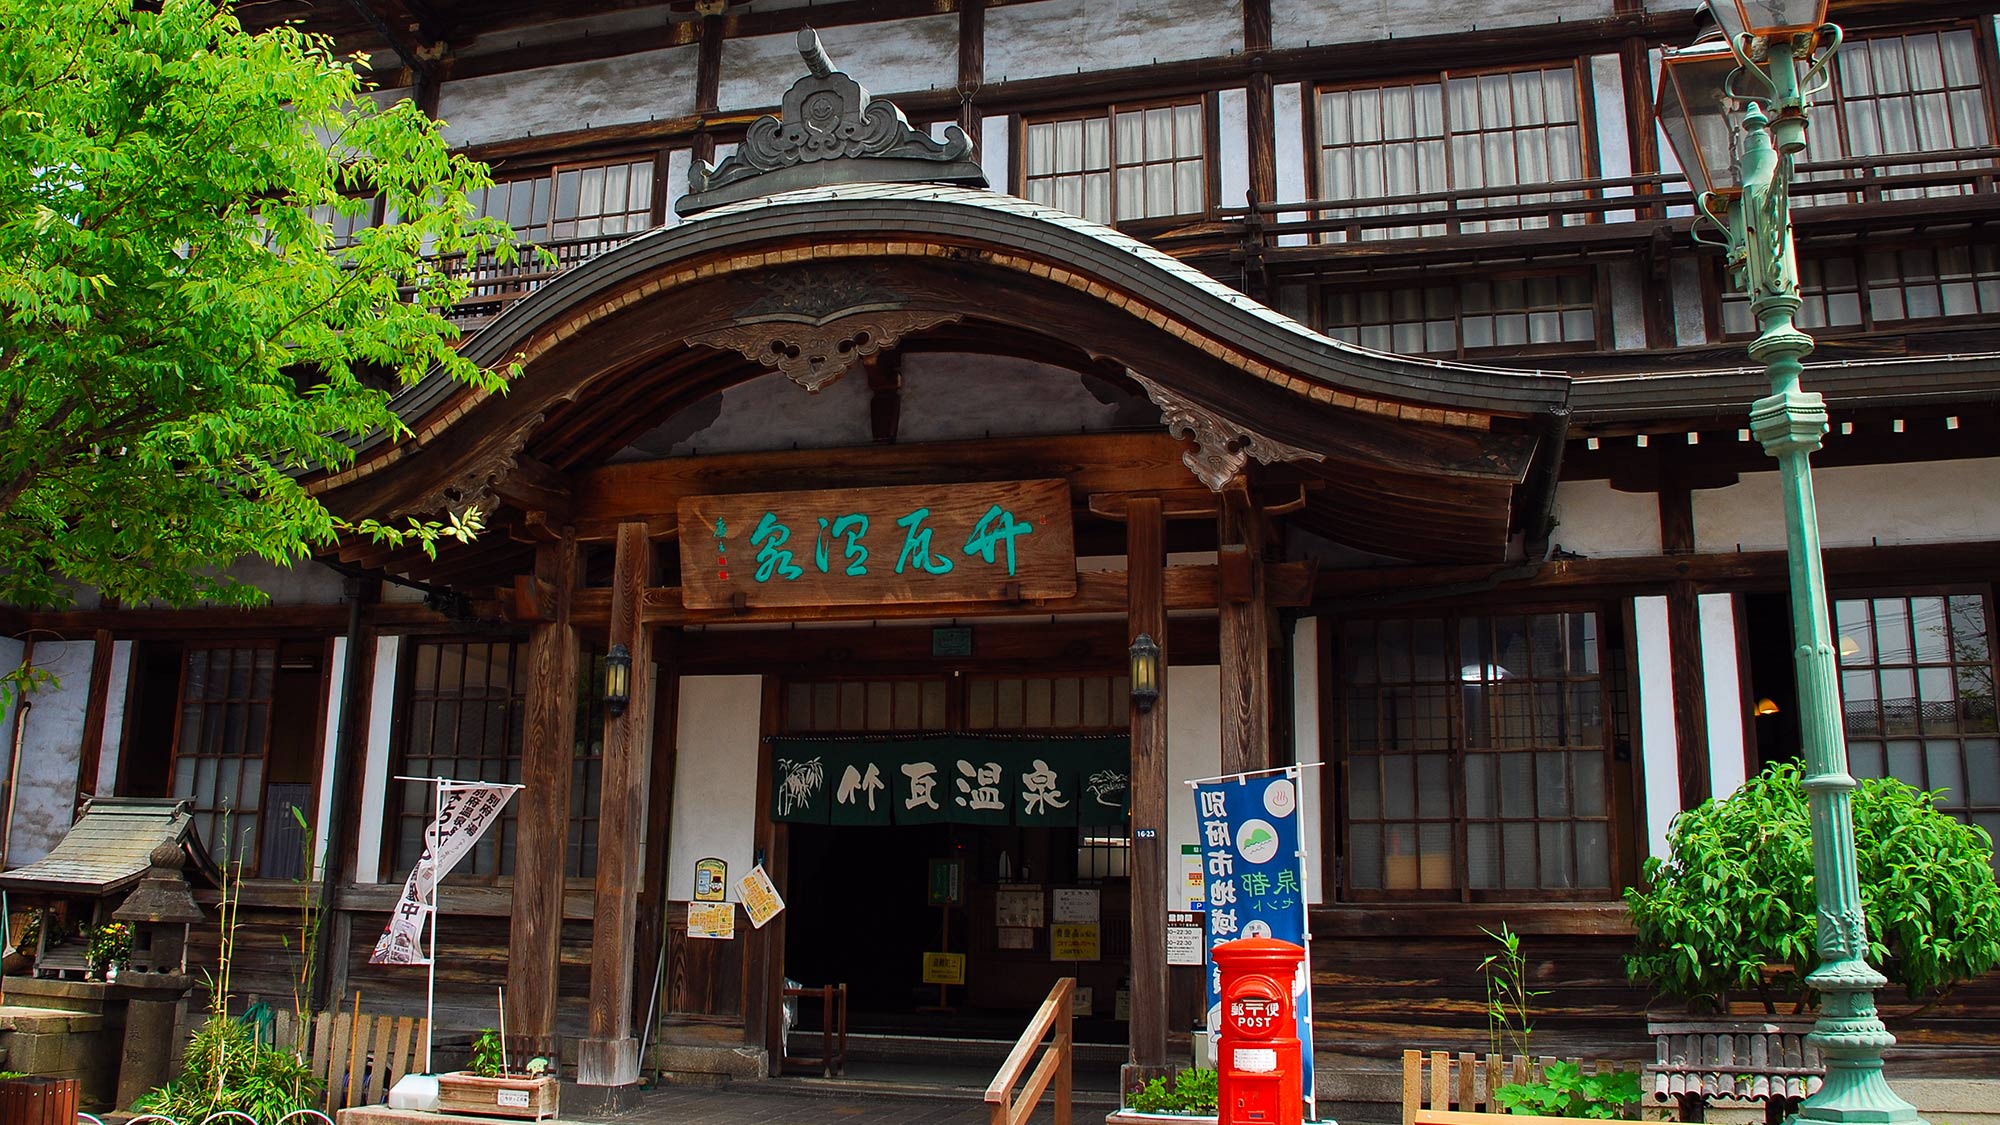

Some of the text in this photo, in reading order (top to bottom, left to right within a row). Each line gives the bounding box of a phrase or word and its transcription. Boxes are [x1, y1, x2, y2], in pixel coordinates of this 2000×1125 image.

[836, 759, 1070, 816] 竹瓦温泉
[463, 793, 502, 838] 別府八湯
[1237, 1016, 1272, 1028] POST
